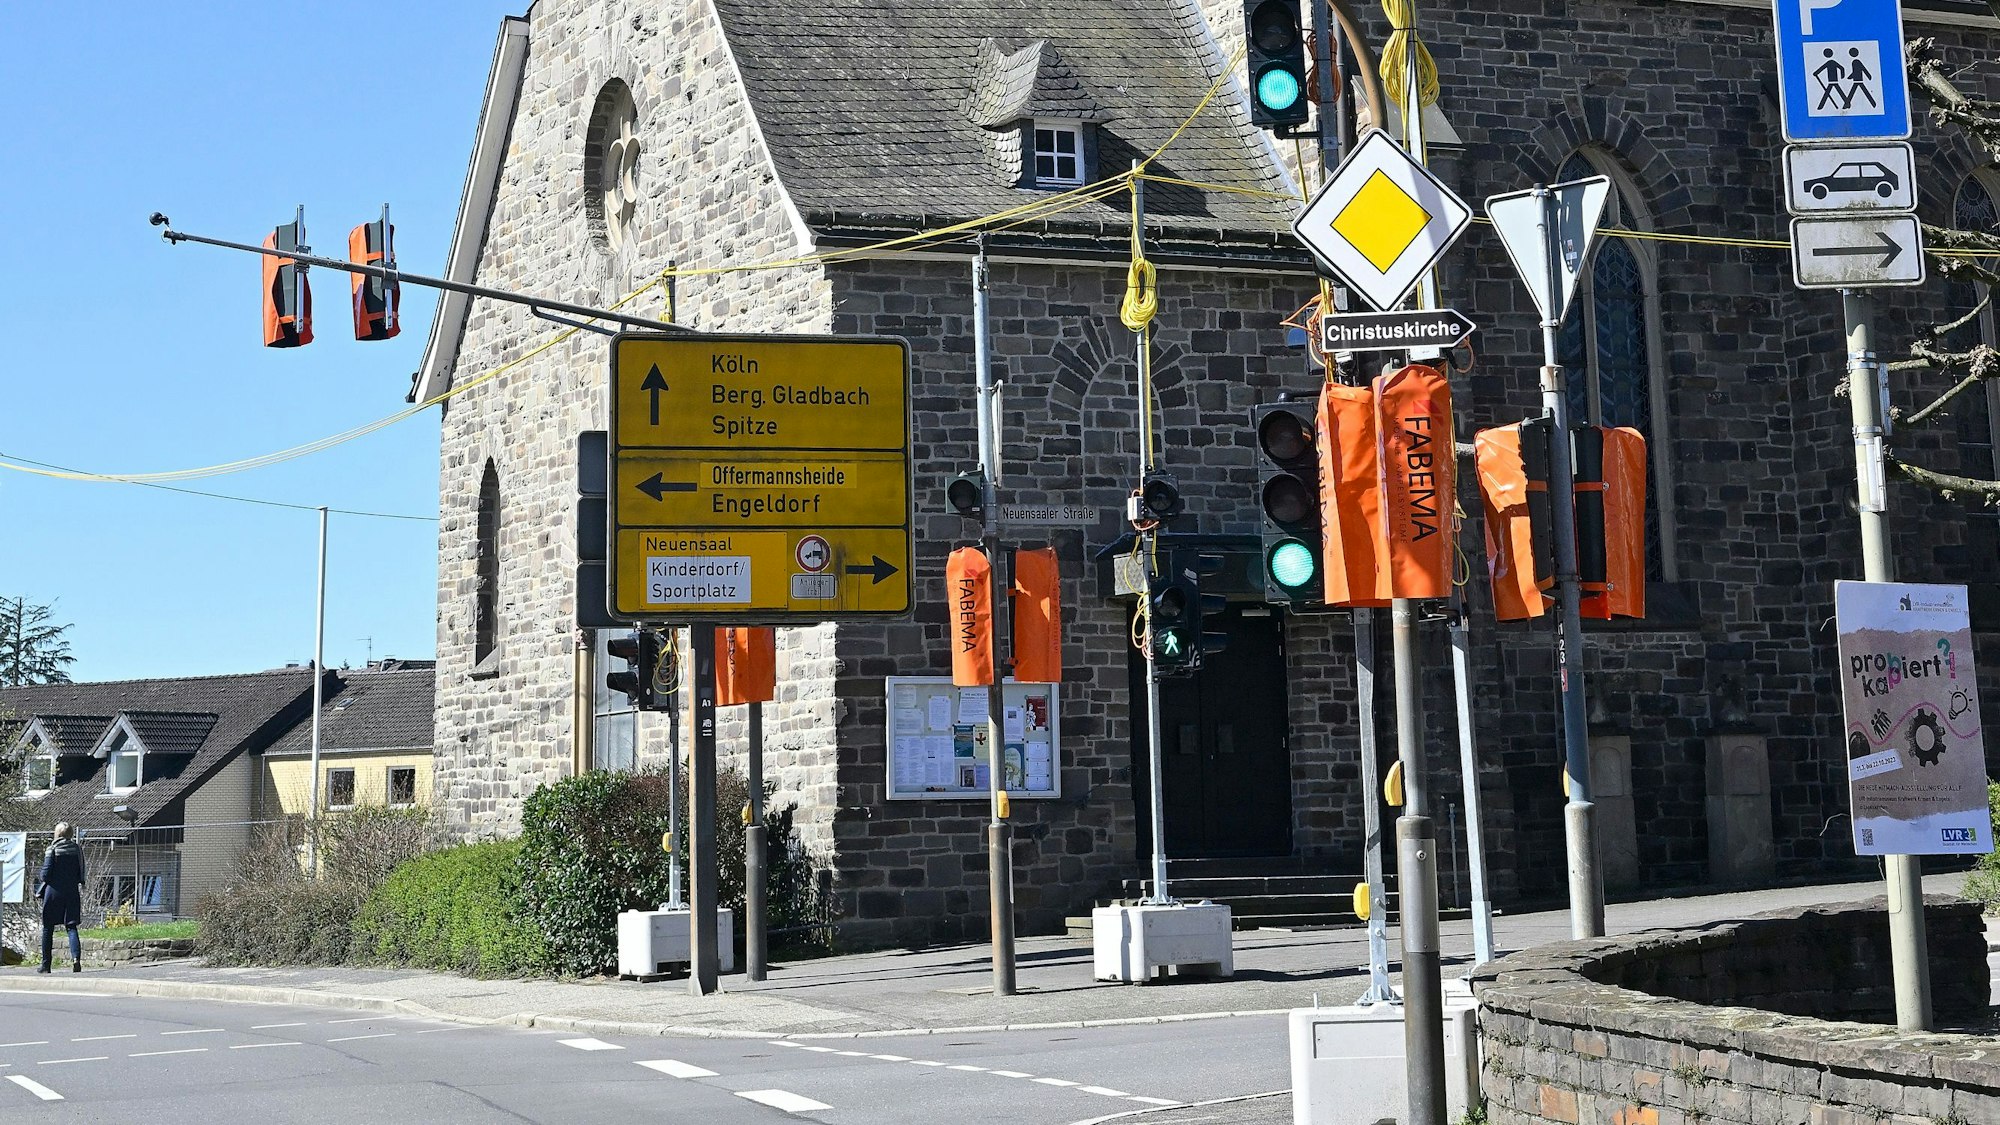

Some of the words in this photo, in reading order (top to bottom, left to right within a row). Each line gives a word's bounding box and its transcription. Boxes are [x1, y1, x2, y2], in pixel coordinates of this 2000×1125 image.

[1326, 320, 1461, 342] Christuskirche
[711, 354, 759, 374] Köln
[711, 384, 767, 409] Berg.
[772, 384, 870, 406] Gladbach
[711, 415, 778, 440] Spitze
[711, 465, 846, 486] Offermannsheide
[1404, 416, 1438, 543] FABEMA
[711, 493, 821, 518] Engeldorf
[1002, 506, 1059, 520] Neuensaaler
[1063, 506, 1094, 520] Straße
[645, 536, 732, 552] Neuensaal
[651, 561, 746, 577] Kinderdorf/
[652, 582, 736, 602] Sportplatz
[959, 579, 977, 653] FABEMA
[1942, 829, 1963, 841] LVR
